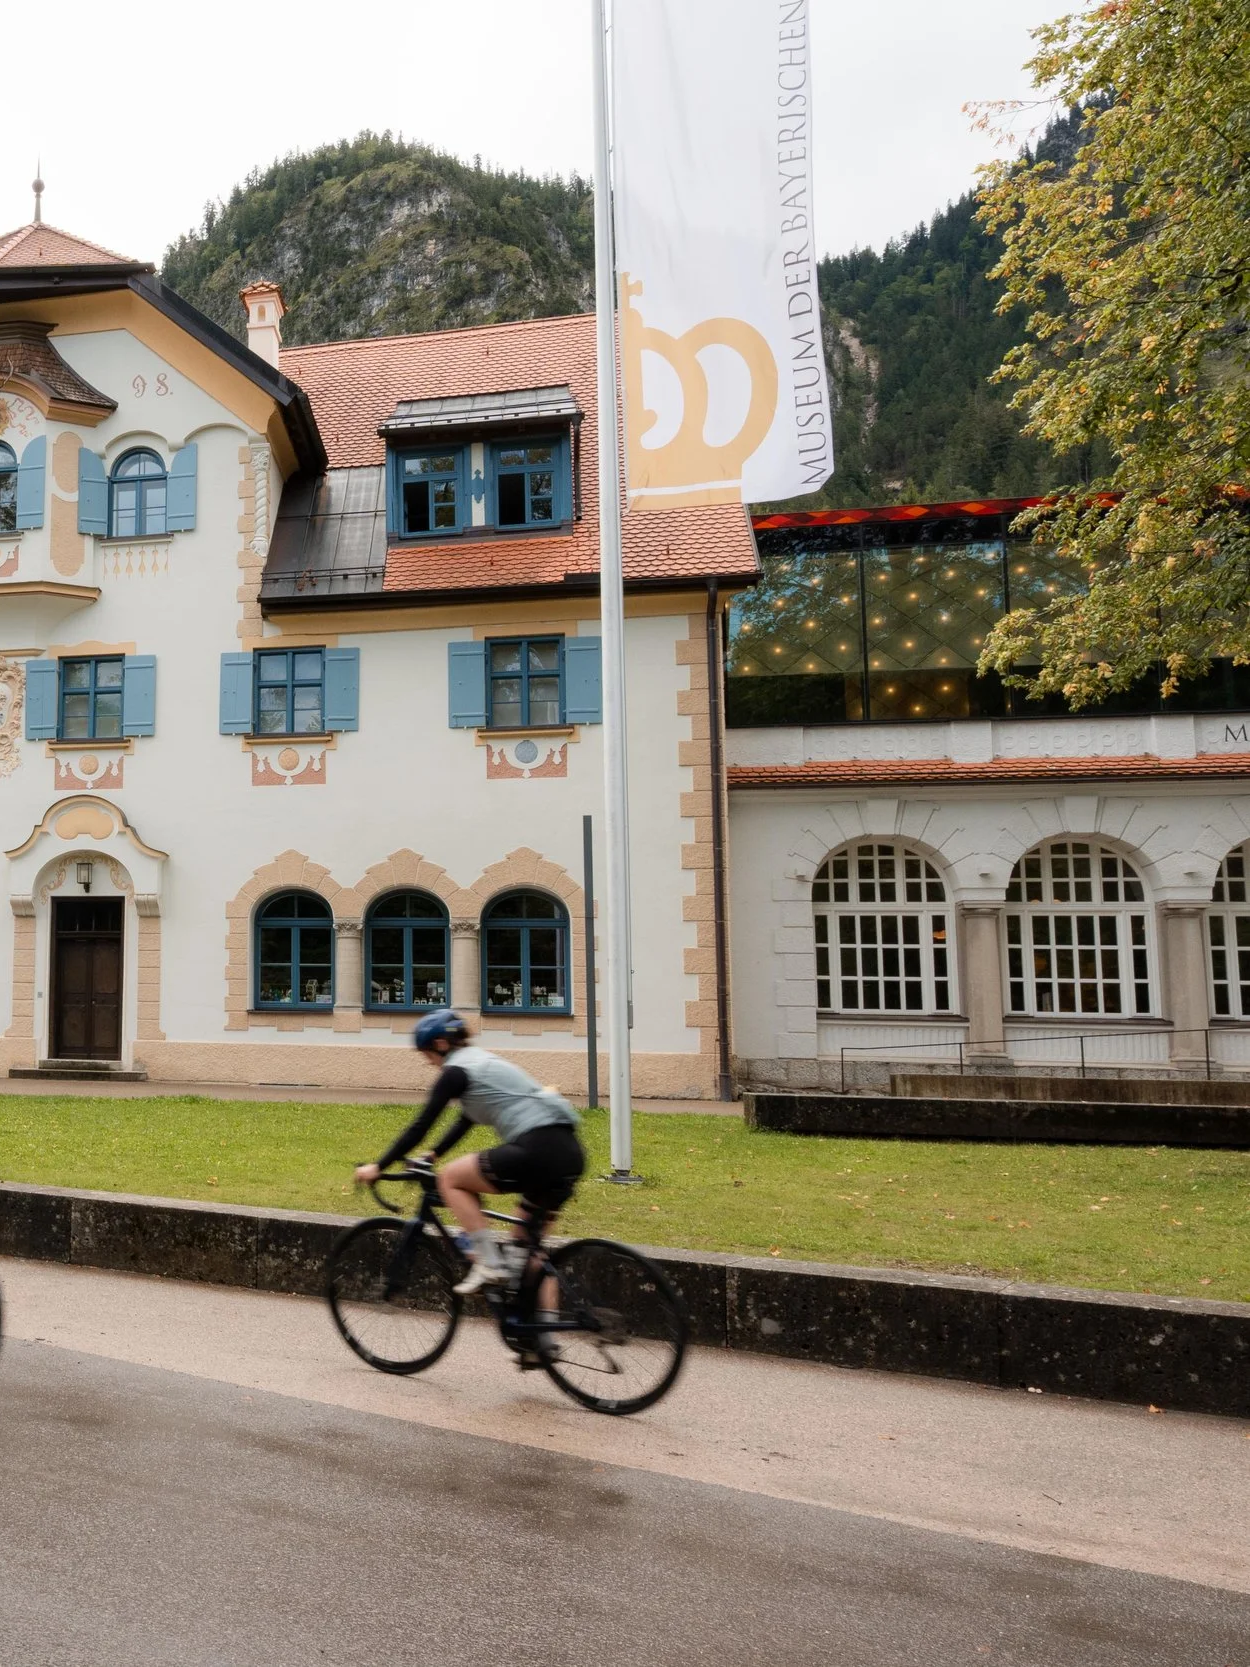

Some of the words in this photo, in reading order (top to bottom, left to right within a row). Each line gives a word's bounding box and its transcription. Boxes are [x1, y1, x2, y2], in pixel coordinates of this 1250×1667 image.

[777, 0, 808, 237] BAYERISCHEN
[782, 239, 813, 320] DER
[789, 327, 827, 484] MUSEUM
